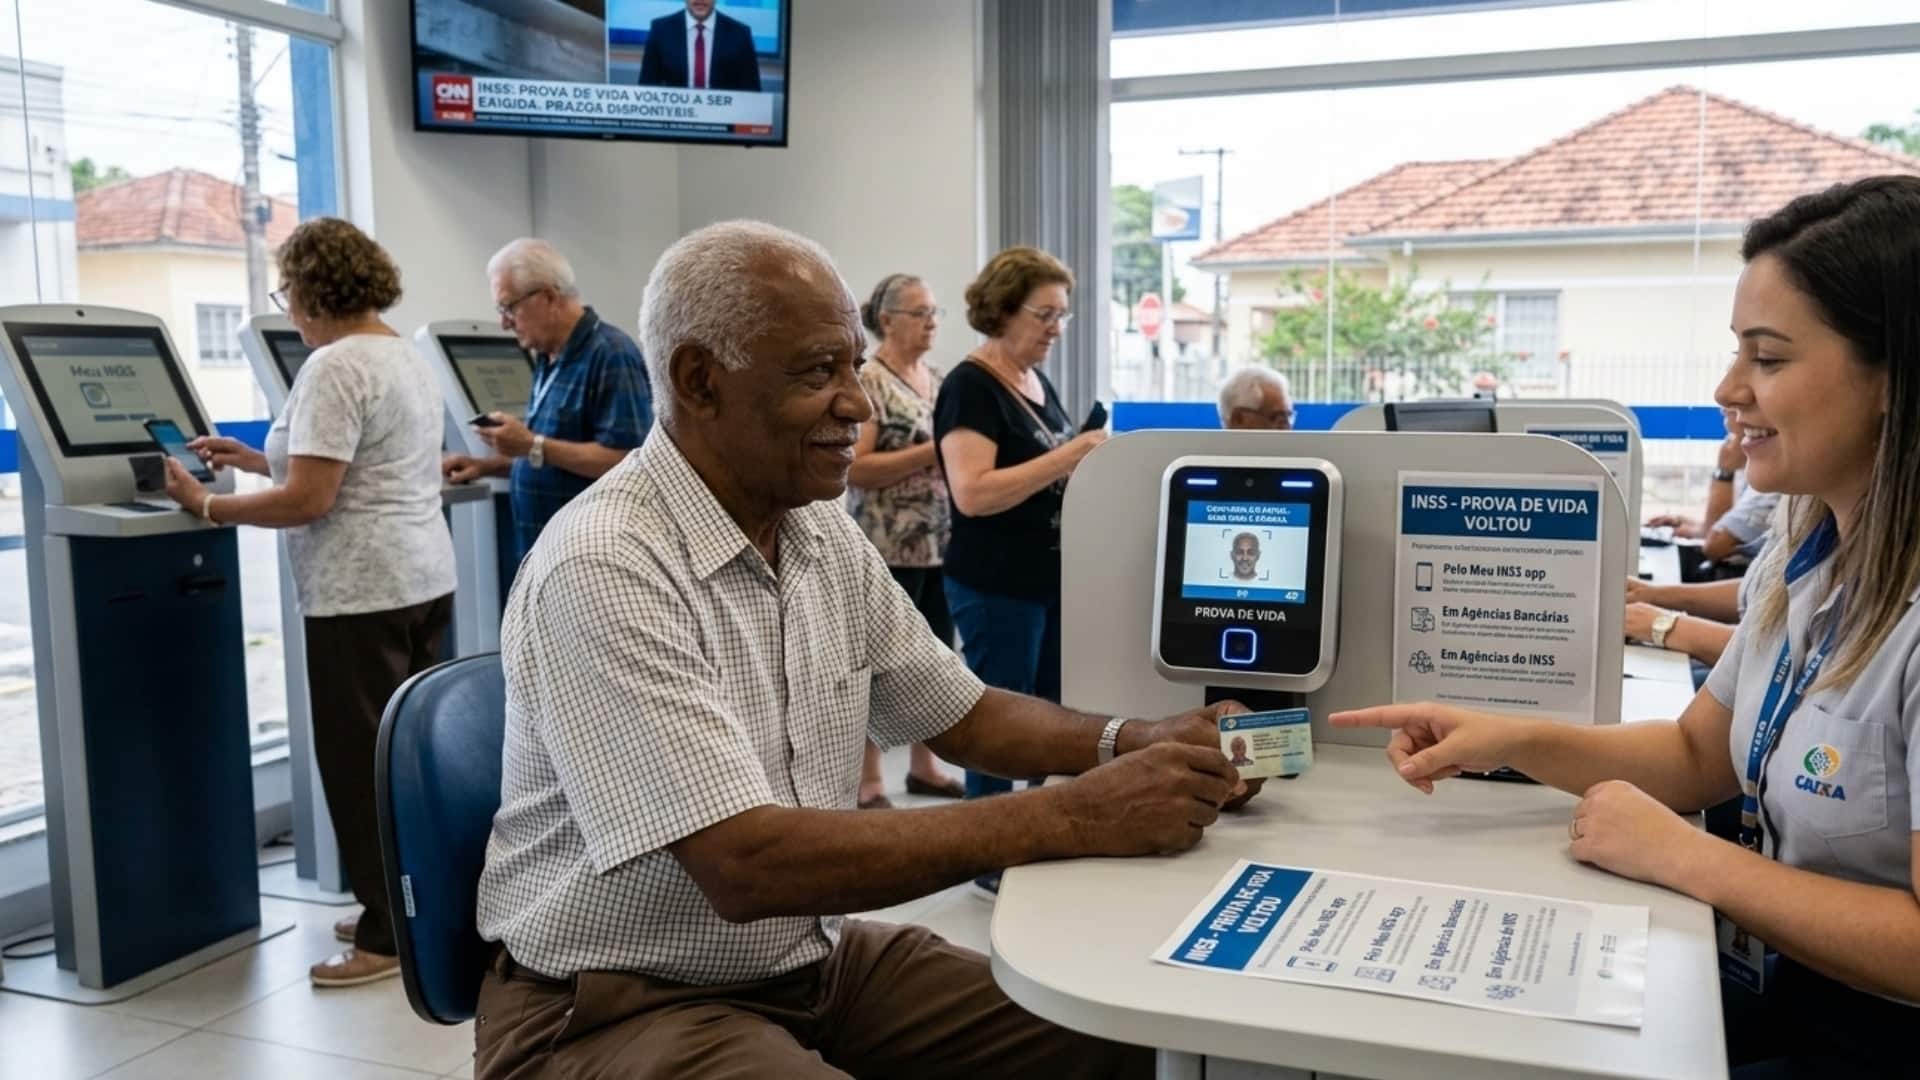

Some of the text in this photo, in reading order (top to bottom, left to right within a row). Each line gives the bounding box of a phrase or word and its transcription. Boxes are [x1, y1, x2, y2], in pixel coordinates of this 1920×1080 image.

[520, 84, 568, 97] PROVA
[573, 87, 591, 98] DE
[596, 88, 629, 101] VIDA
[693, 93, 703, 105] A
[707, 94, 733, 107] SER
[1411, 494, 1447, 510] INSS
[1461, 495, 1516, 512] PROVA
[1521, 497, 1543, 513] DE
[1547, 498, 1589, 515] VIDA
[1464, 515, 1532, 532] VOLTOU
[1443, 563, 1468, 577] Pelo
[1470, 564, 1494, 577] Meu
[1497, 565, 1522, 578] INSS
[1195, 606, 1286, 622] PROVA DE VIDA
[1442, 606, 1458, 617] Em
[1513, 608, 1569, 624] Bancárias
[1441, 648, 1457, 660] Em
[1512, 653, 1526, 665] do
[1529, 655, 1555, 667] INSS
